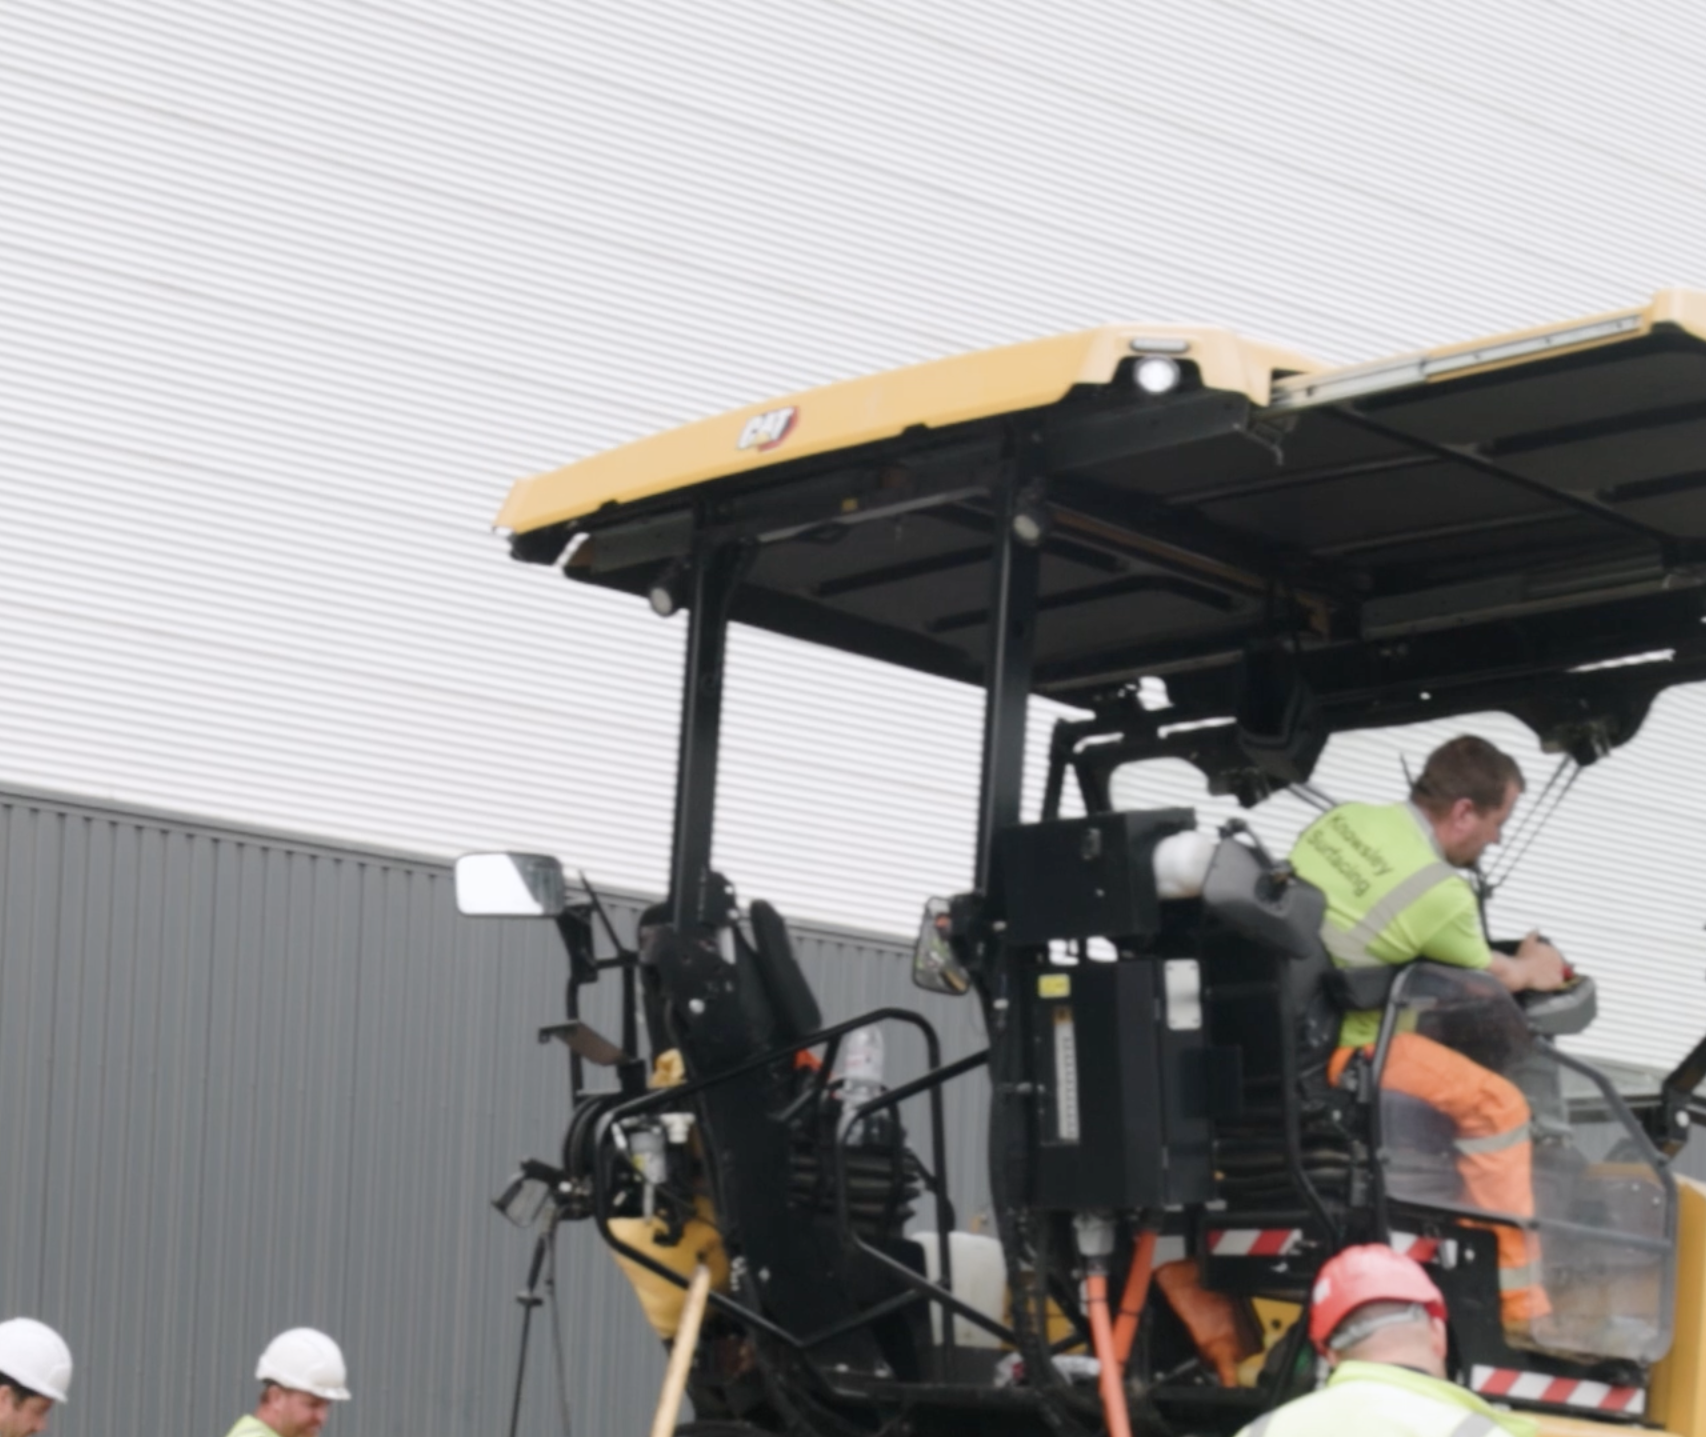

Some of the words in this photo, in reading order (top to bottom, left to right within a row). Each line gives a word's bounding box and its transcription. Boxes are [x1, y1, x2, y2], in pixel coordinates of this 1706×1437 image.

[737, 407, 795, 449] CAT
[1306, 829, 1372, 898] Surfacing
[1329, 814, 1395, 877] Knowsley
